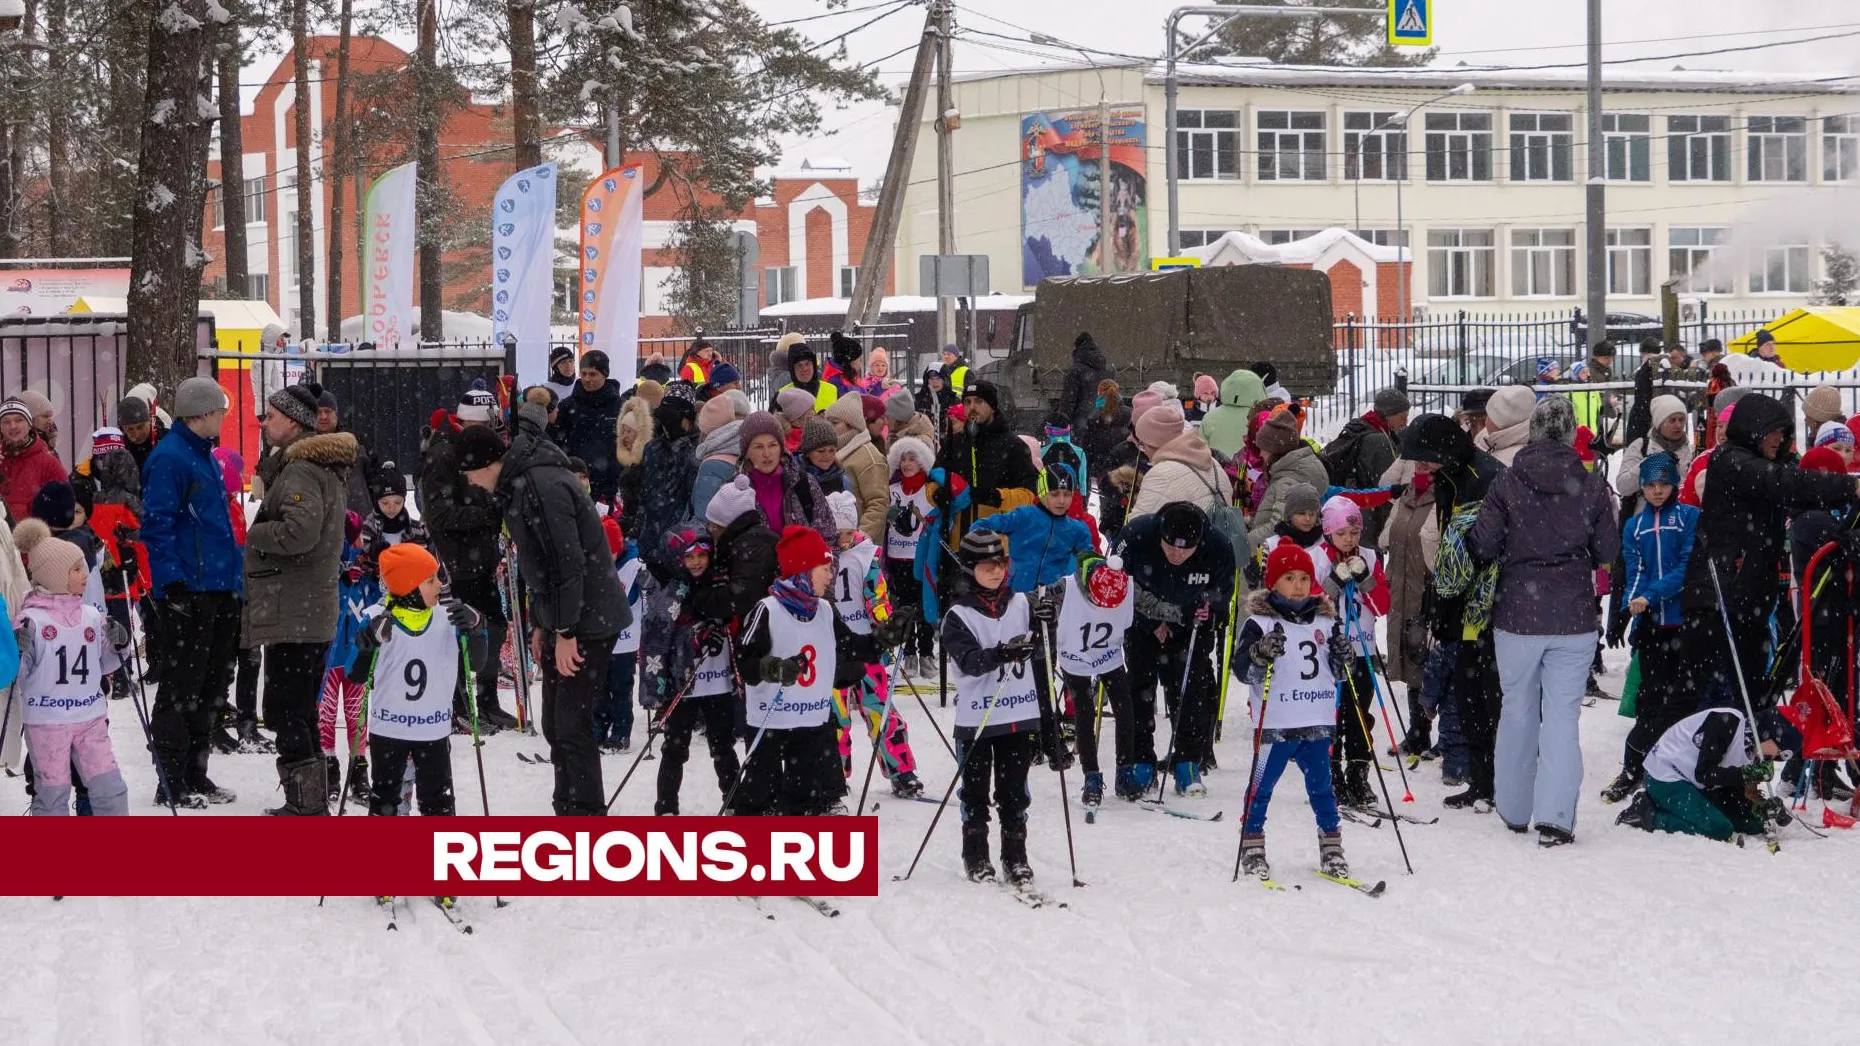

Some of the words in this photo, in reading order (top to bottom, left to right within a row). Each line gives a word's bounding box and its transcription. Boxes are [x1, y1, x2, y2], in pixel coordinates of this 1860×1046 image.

[1188, 573, 1209, 585] HH
[1080, 622, 1113, 652] 12
[55, 645, 89, 685] 14
[404, 659, 427, 701] 9
[1299, 641, 1319, 680] 3
